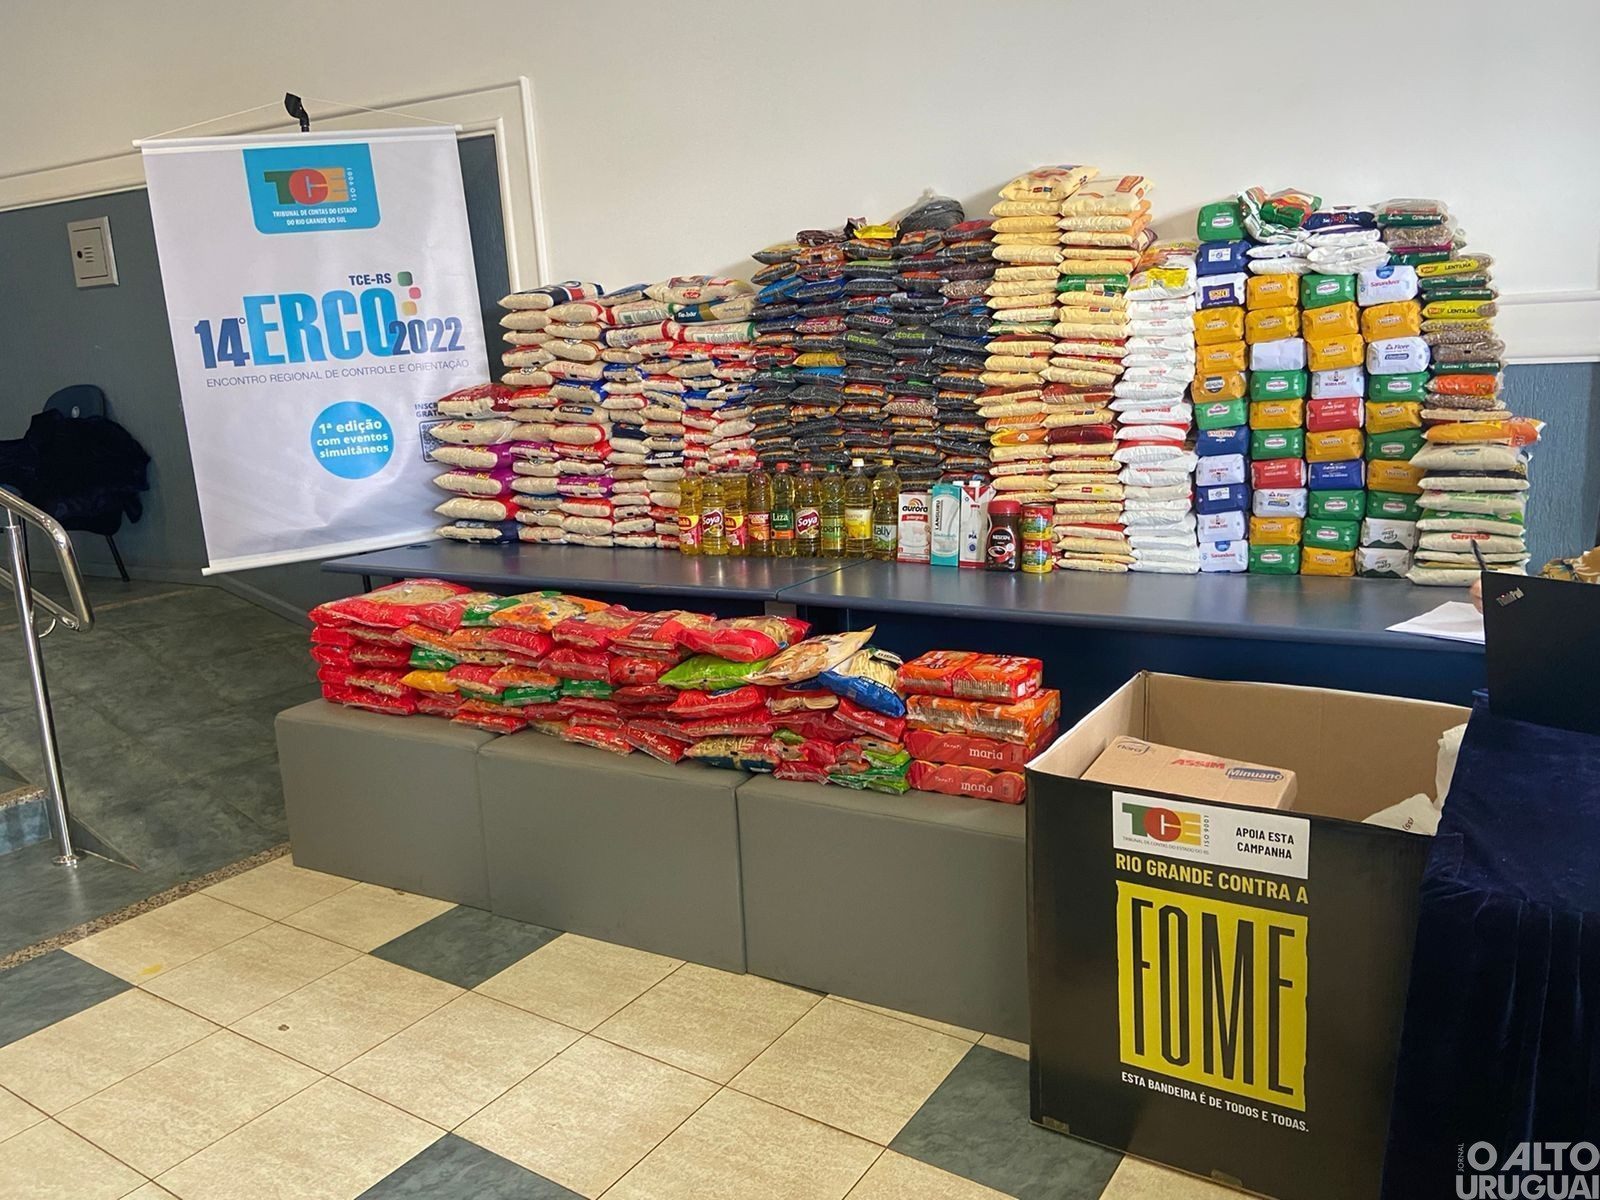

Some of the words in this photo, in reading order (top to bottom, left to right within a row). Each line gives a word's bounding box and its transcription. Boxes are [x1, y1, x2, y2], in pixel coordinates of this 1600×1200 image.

[264, 167, 349, 205] TCE
[272, 210, 300, 218] TRIBUNAL
[308, 208, 329, 216] CONTAS
[305, 217, 327, 225] GRANDE
[348, 273, 392, 286] TCE-RS
[242, 287, 398, 367] ERCO
[388, 316, 466, 356] 2022
[207, 374, 267, 388] ENCONTRO
[270, 370, 322, 383] REGIONAL
[325, 369, 339, 379] DE
[341, 364, 396, 377] CONTROLE
[399, 363, 405, 373] E
[407, 359, 470, 372] ORIENTAÇÃO
[336, 419, 382, 434] edição
[317, 437, 340, 446] com
[343, 433, 388, 444] eventos
[319, 444, 389, 458] simultâneos
[902, 505, 928, 513] aurora
[772, 511, 789, 521] Liza
[797, 515, 818, 528] Soya
[969, 748, 1003, 760] maria
[1171, 758, 1226, 770] ASSIM
[1227, 768, 1284, 781] Minuano
[961, 782, 993, 794] maria
[1122, 803, 1201, 845] TCE
[1236, 827, 1266, 841] APOIA
[1268, 831, 1295, 845] ESTA
[1237, 841, 1292, 860] CAMPANHA
[1115, 852, 1142, 874] RIO
[1146, 858, 1214, 888] GRANDE
[1218, 872, 1291, 902] CONTRA
[1295, 886, 1309, 905] A
[1131, 896, 1295, 1096] FOME
[1122, 1071, 1146, 1088] ESTA
[1148, 1078, 1198, 1104] BANDEIRA
[1199, 1091, 1206, 1104] É
[1209, 1097, 1222, 1109] DE
[1225, 1100, 1259, 1119] TODOS
[1262, 1110, 1268, 1122] E
[1271, 1112, 1310, 1133] TODAS.
